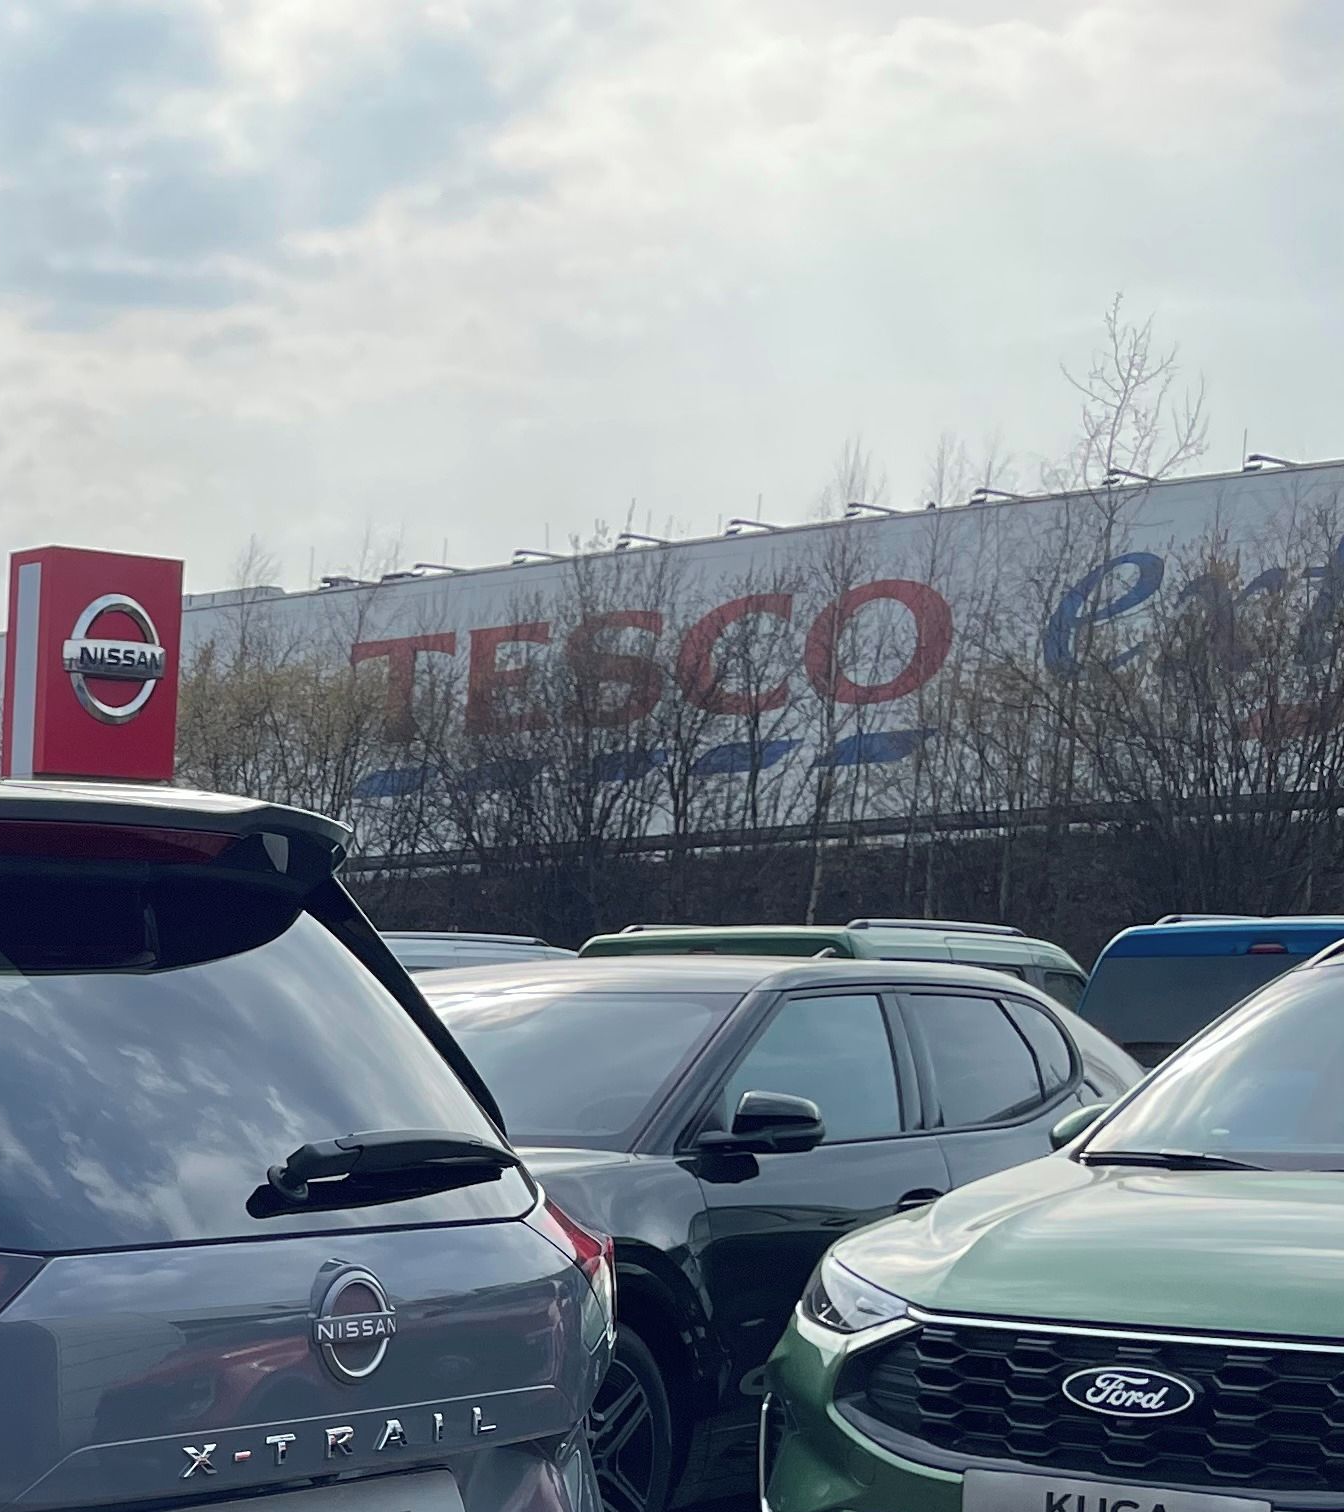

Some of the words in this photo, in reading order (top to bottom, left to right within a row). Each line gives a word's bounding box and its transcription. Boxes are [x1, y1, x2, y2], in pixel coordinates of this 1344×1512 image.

[79, 647, 165, 670] NISSAN
[351, 578, 954, 745] TESCO
[318, 1318, 397, 1340] NISSAN
[1085, 1373, 1170, 1409] Ford
[179, 1406, 498, 1479] X-TRAIL
